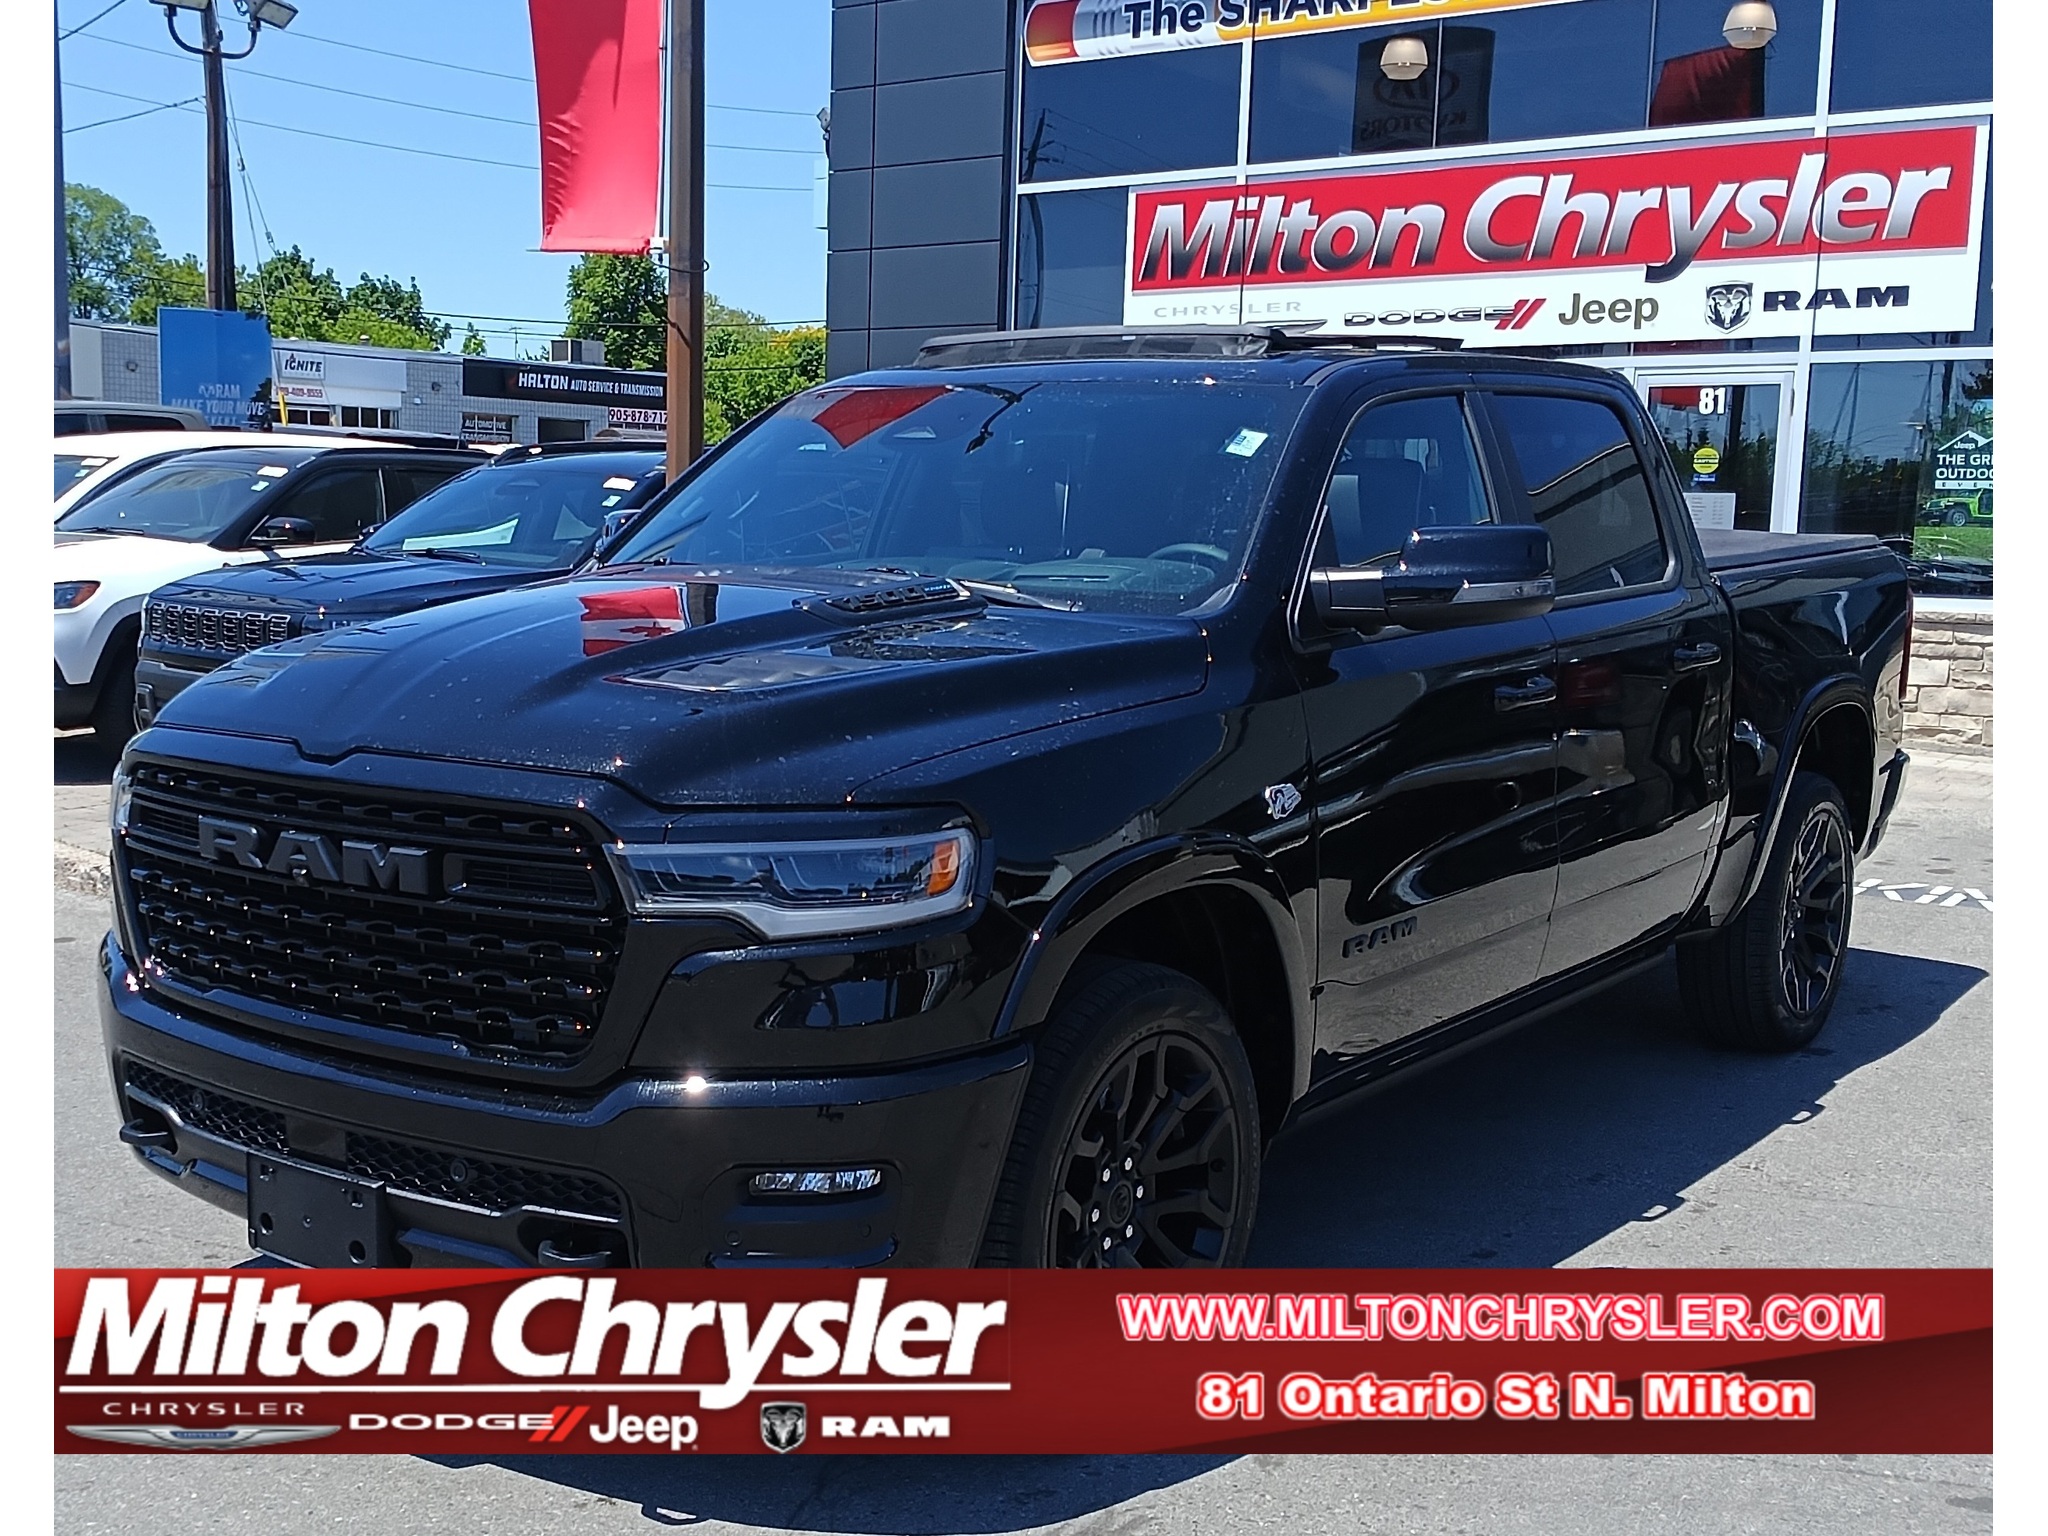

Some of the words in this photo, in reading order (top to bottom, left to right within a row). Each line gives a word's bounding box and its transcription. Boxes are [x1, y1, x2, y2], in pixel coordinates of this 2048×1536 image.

[1124, 0, 1205, 39] The
[1138, 193, 1447, 283] Milton
[1462, 151, 1952, 283] Chrysler
[1153, 301, 1302, 318] CHRYSLER
[1558, 292, 1659, 330] Jeep
[1763, 285, 1910, 312] RAM
[1344, 303, 1514, 328] DODGE
[284, 358, 323, 373] IGNITE
[216, 384, 241, 398] RAM
[518, 372, 569, 390] HALTON
[570, 379, 588, 392] AUTO
[588, 380, 613, 394] SERVICE
[620, 383, 664, 398] TRANSMISSION
[205, 399, 234, 414] YOUR
[1698, 387, 1727, 415] 81
[1954, 441, 1976, 450] Jeep
[1937, 454, 1966, 466] THE
[198, 815, 432, 896] RAM
[1342, 916, 1418, 958] RAM
